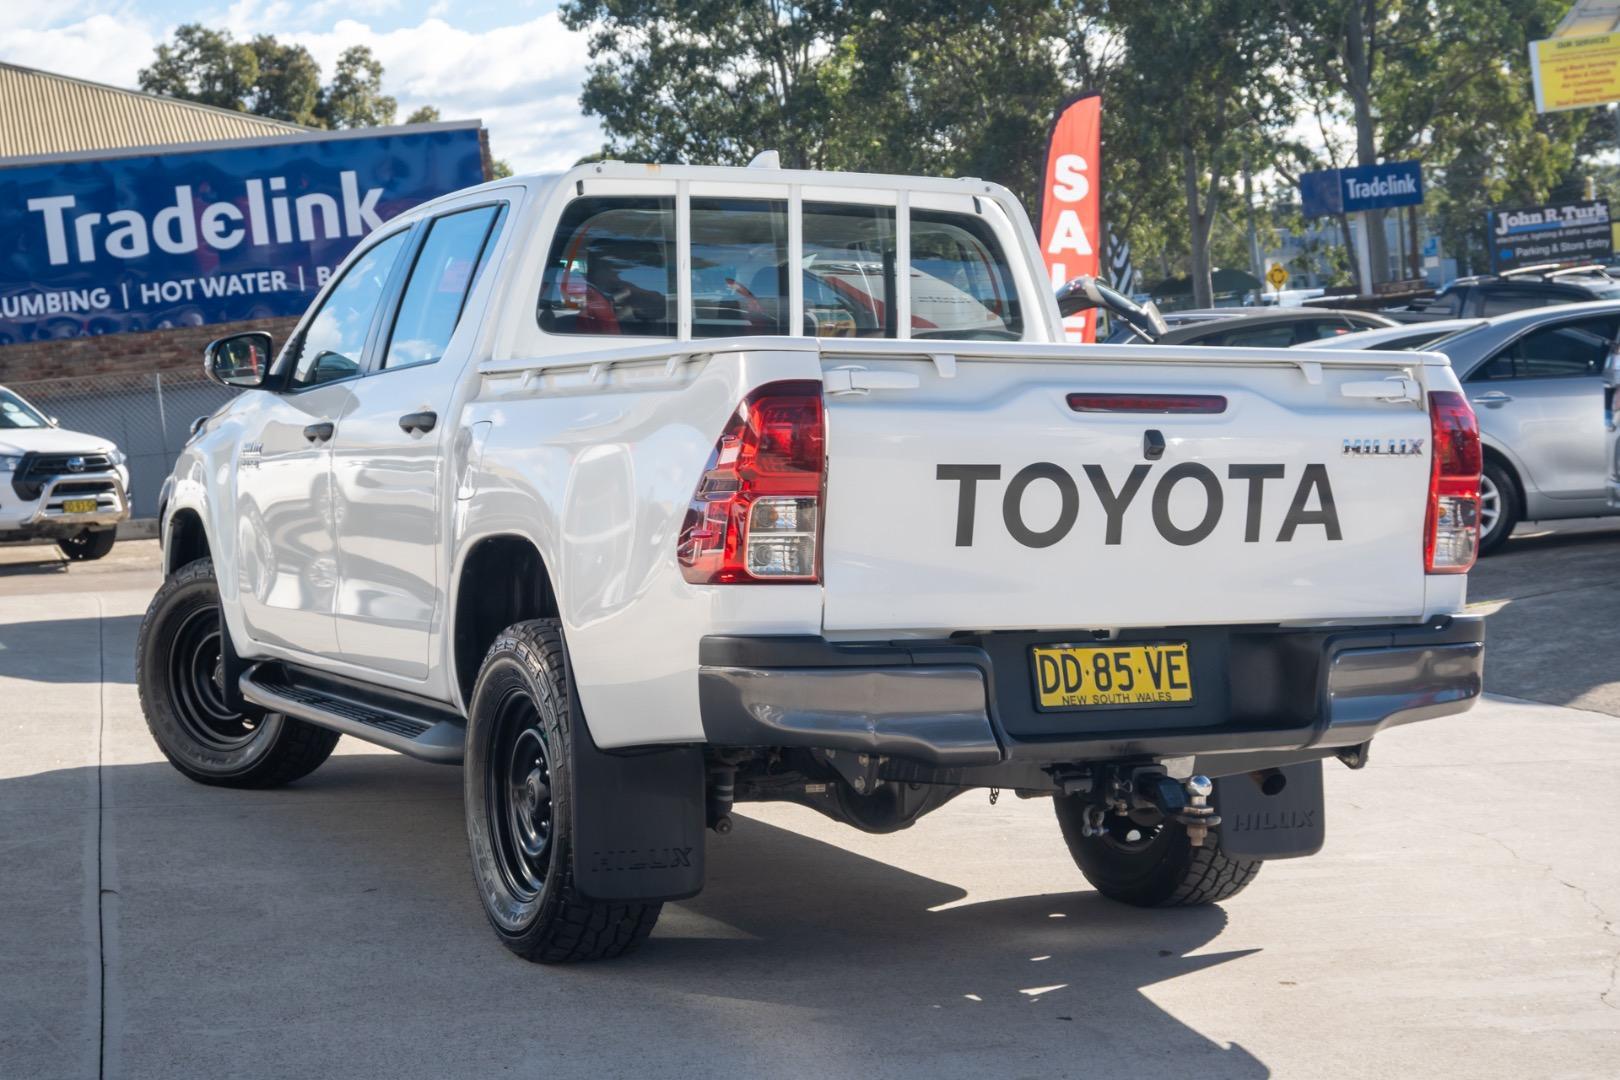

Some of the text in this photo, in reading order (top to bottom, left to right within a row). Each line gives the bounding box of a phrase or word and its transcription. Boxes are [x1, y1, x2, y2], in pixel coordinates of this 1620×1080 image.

[1345, 173, 1417, 199] Tradelink
[27, 170, 385, 265] Tradelink
[1495, 211, 1543, 235] John
[1515, 246, 1550, 257] Parking
[1560, 241, 1585, 252] Store
[1586, 238, 1611, 249] Entry
[0, 287, 111, 318] UMBING
[141, 279, 197, 304] HOT
[199, 270, 288, 298] WATER
[1343, 438, 1425, 456] HILUX
[936, 461, 1343, 548] TOYOTA
[1062, 691, 1172, 706] NEW SOUTH WALES
[1232, 809, 1315, 832] HILUX
